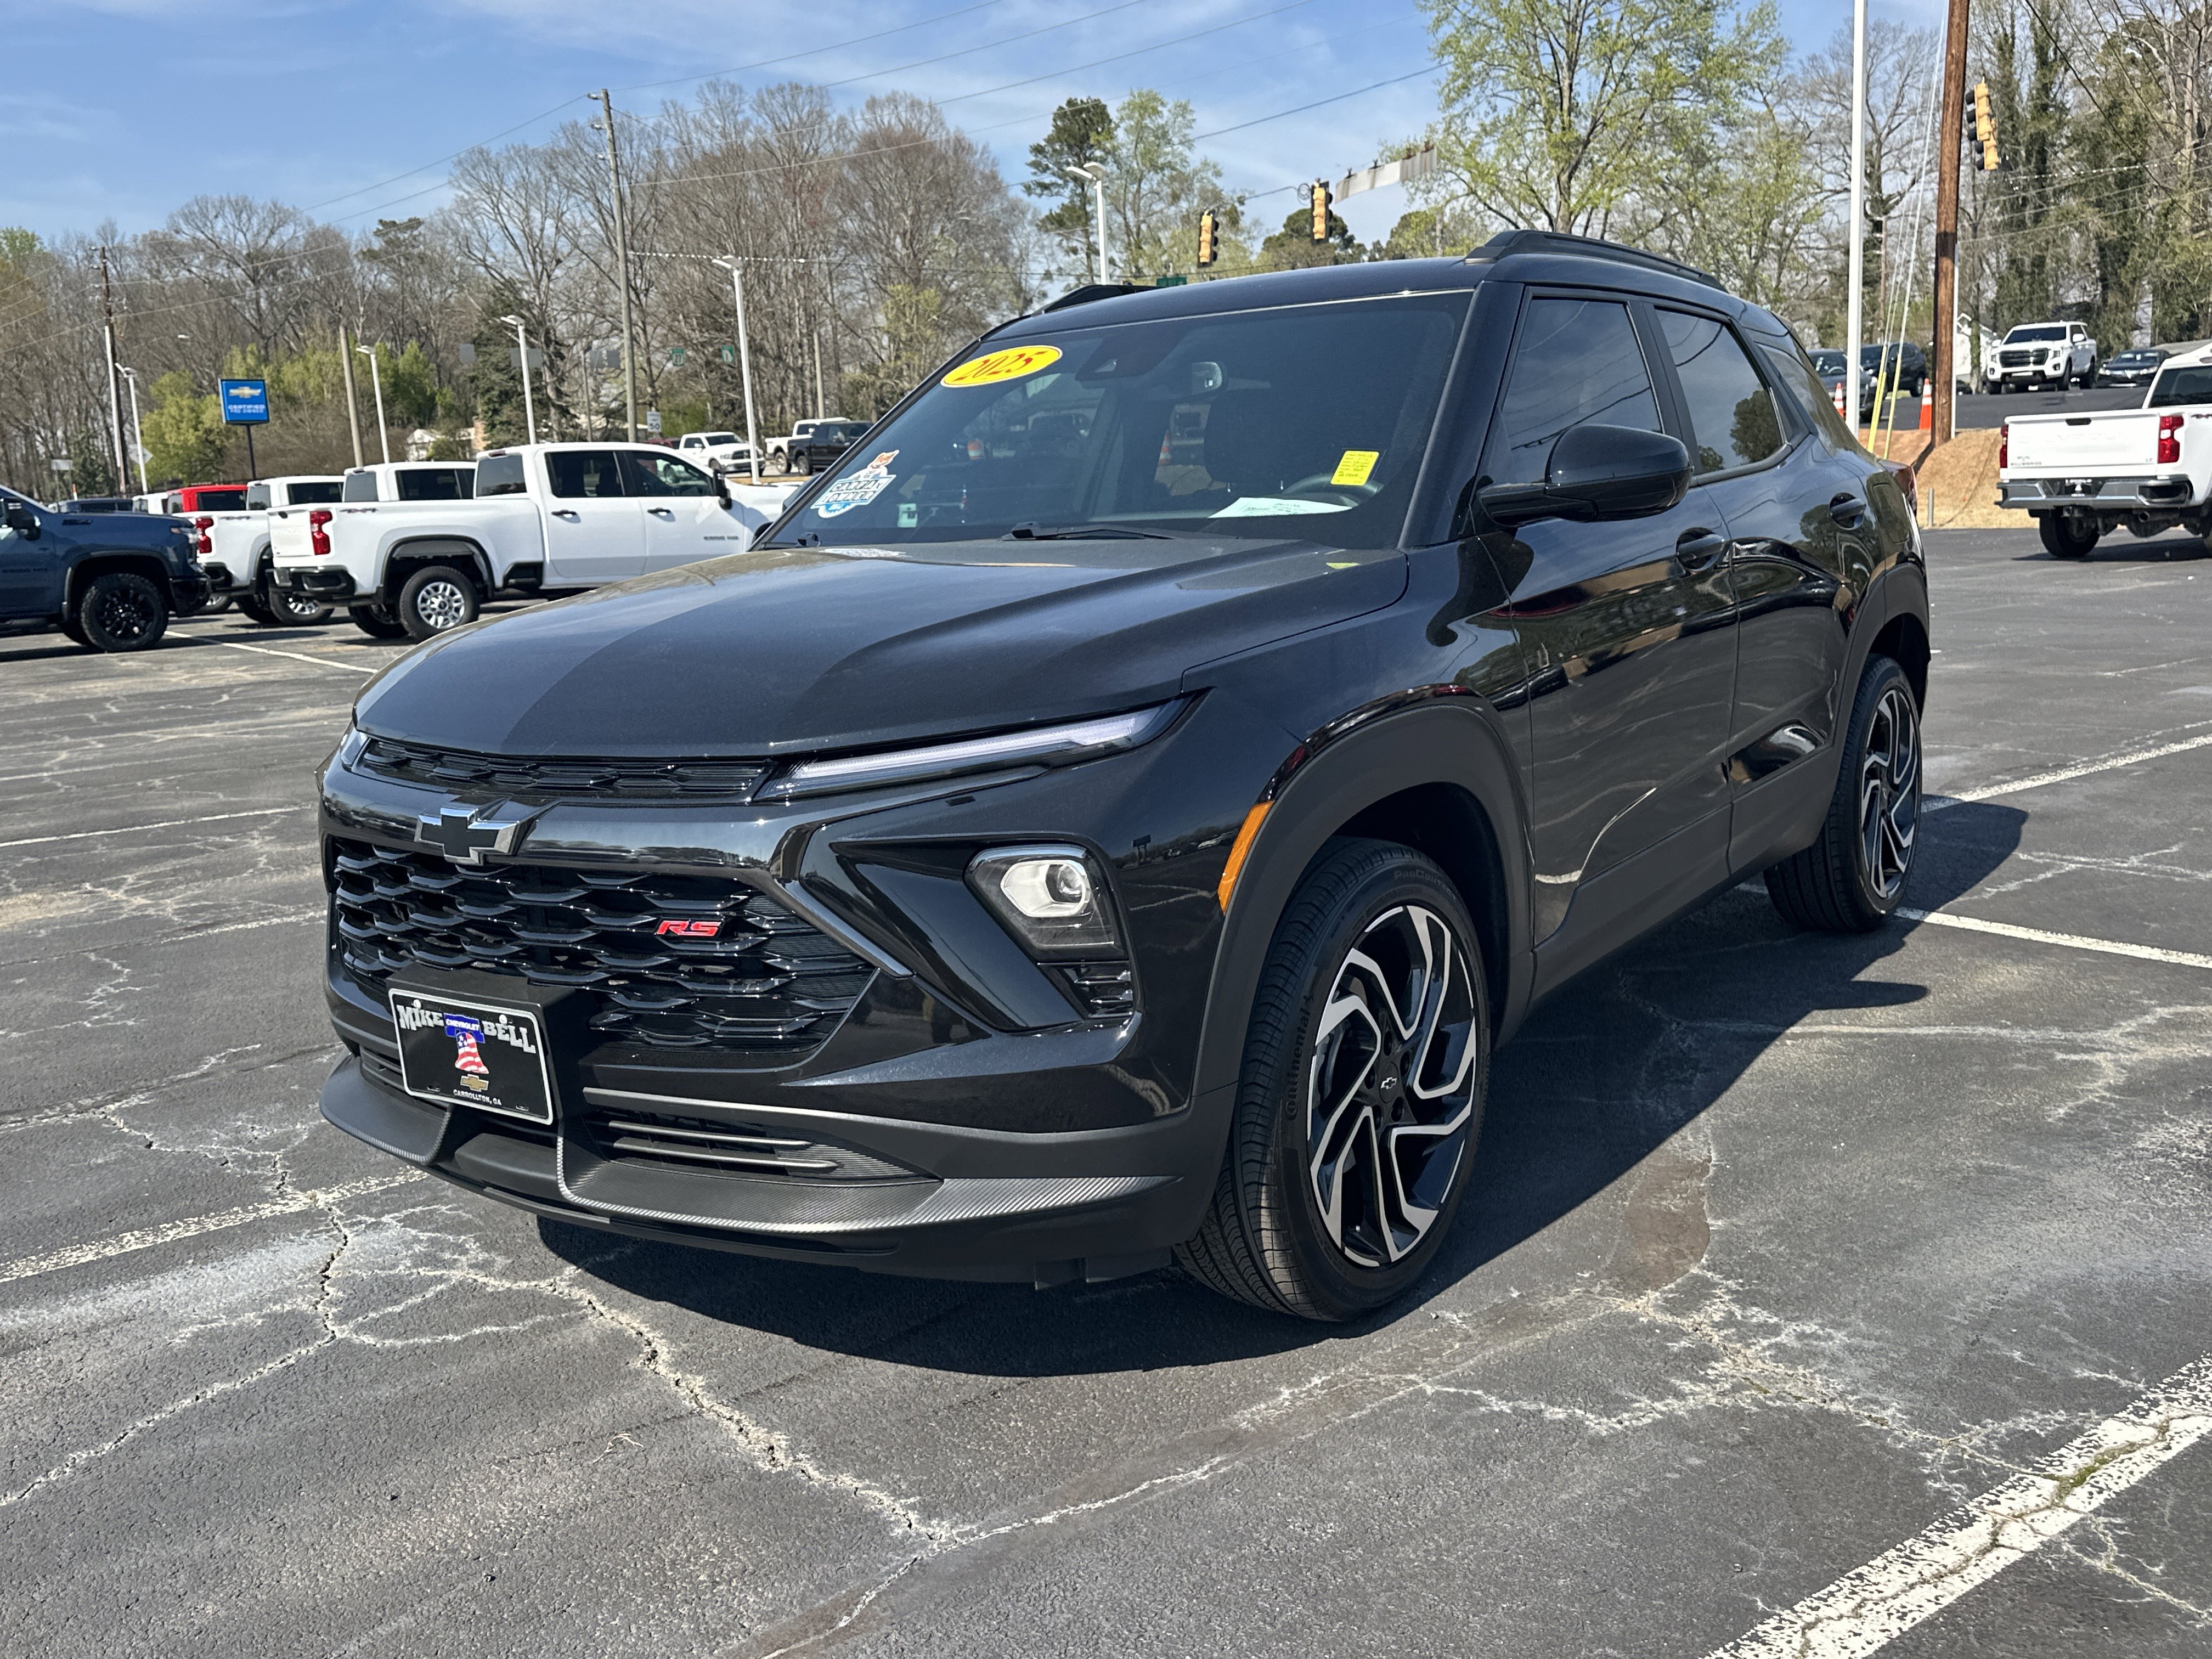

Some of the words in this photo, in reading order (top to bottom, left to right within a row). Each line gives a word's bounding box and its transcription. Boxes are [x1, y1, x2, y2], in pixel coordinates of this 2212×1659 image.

[953, 351, 1048, 382] 2025
[831, 479, 884, 492] CARFAX
[656, 921, 721, 936] RS
[396, 1005, 444, 1031] MIKE
[482, 1020, 537, 1054] BELL
[446, 1018, 480, 1031] CHEVROLET
[1284, 1007, 1311, 1121] Continental
[453, 1088, 492, 1105] CARROLLTON,
[493, 1097, 502, 1106] GA
